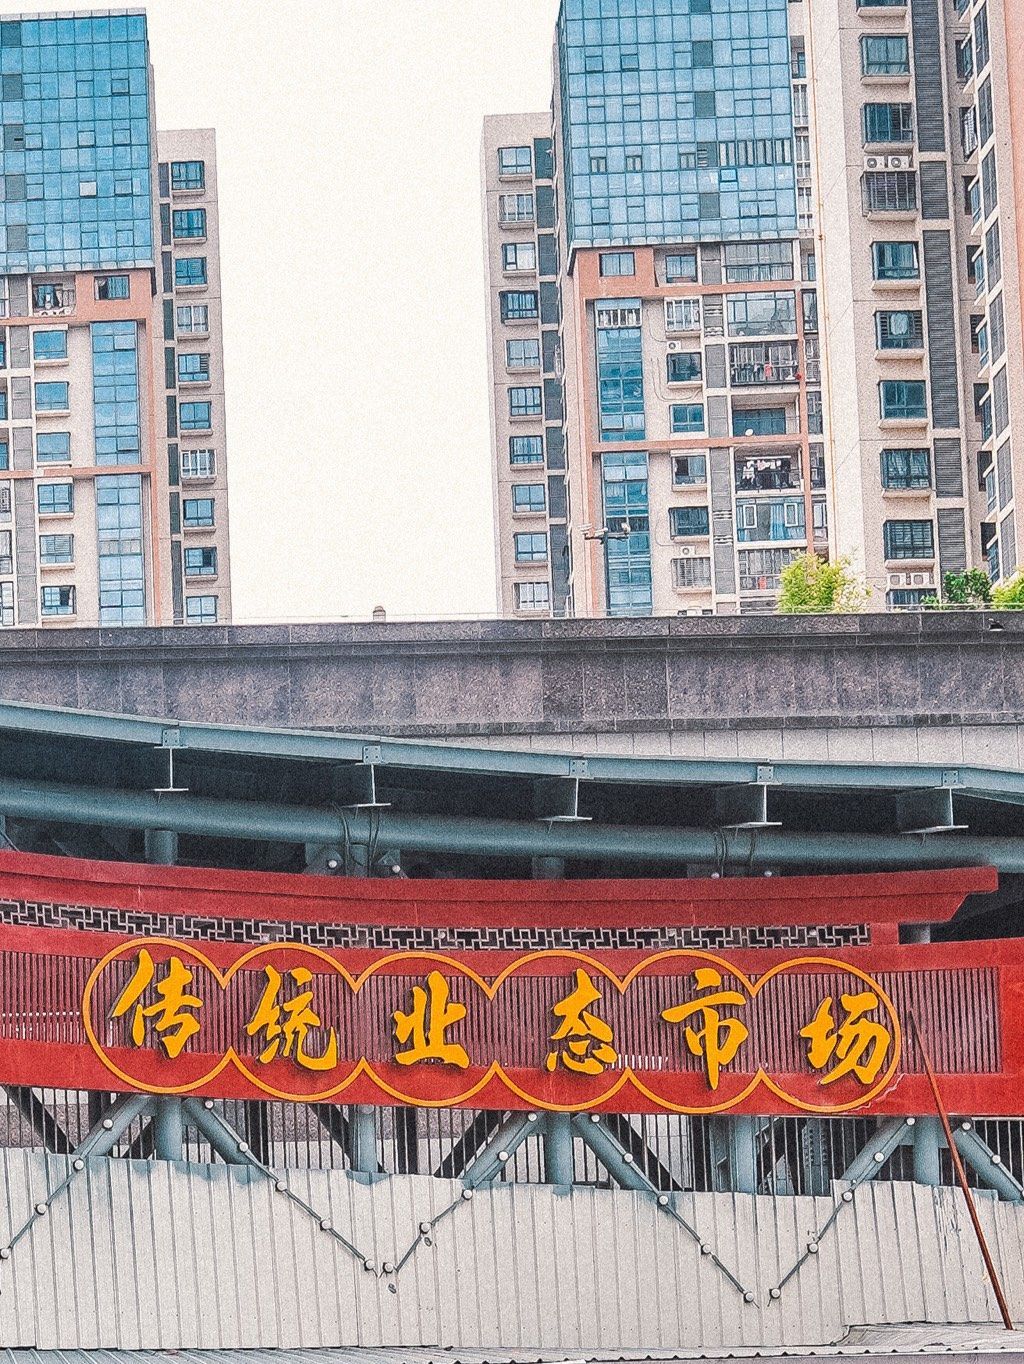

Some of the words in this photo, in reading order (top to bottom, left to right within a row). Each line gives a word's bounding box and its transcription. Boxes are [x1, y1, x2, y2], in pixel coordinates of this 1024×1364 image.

[109, 948, 893, 1091] 传统业态市场
